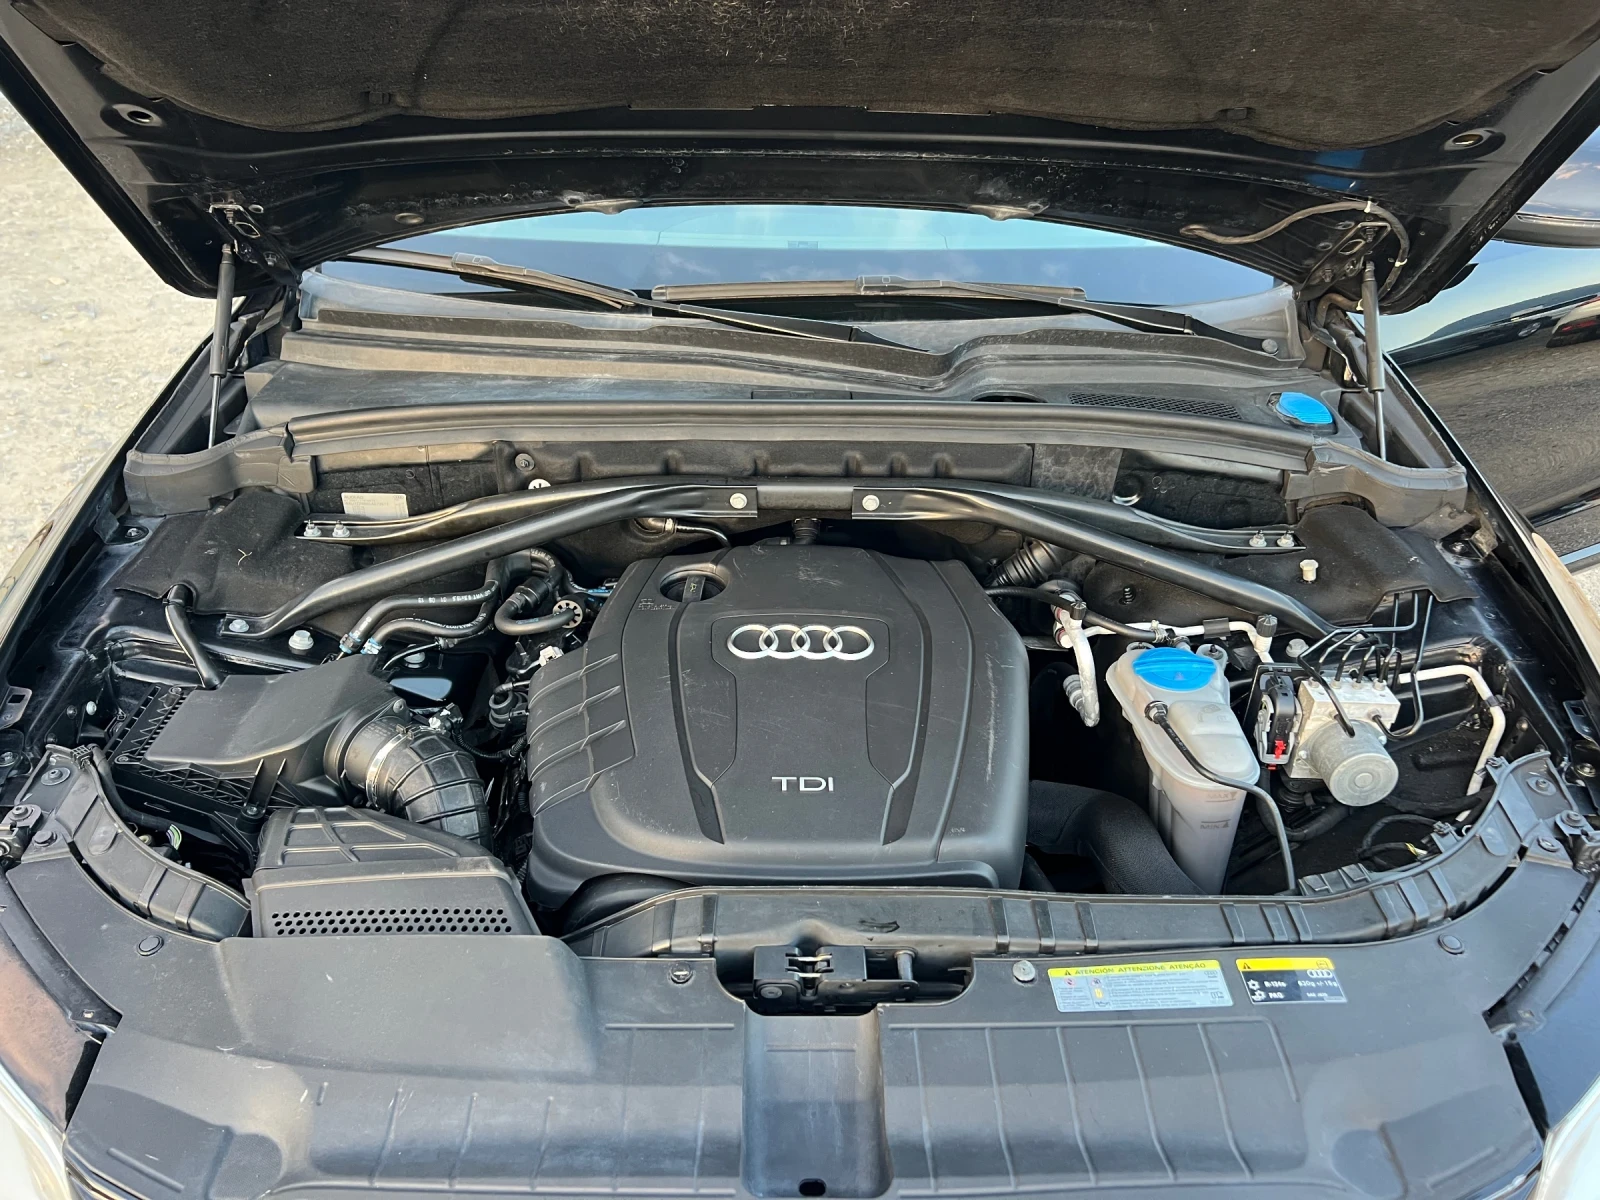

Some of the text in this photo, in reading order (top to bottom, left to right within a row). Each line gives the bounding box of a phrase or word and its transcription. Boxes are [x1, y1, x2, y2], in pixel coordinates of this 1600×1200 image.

[772, 776, 834, 791] TDI
[1075, 962, 1206, 975] ATENCIÓN ATTENZIONE ATENÇÃO
